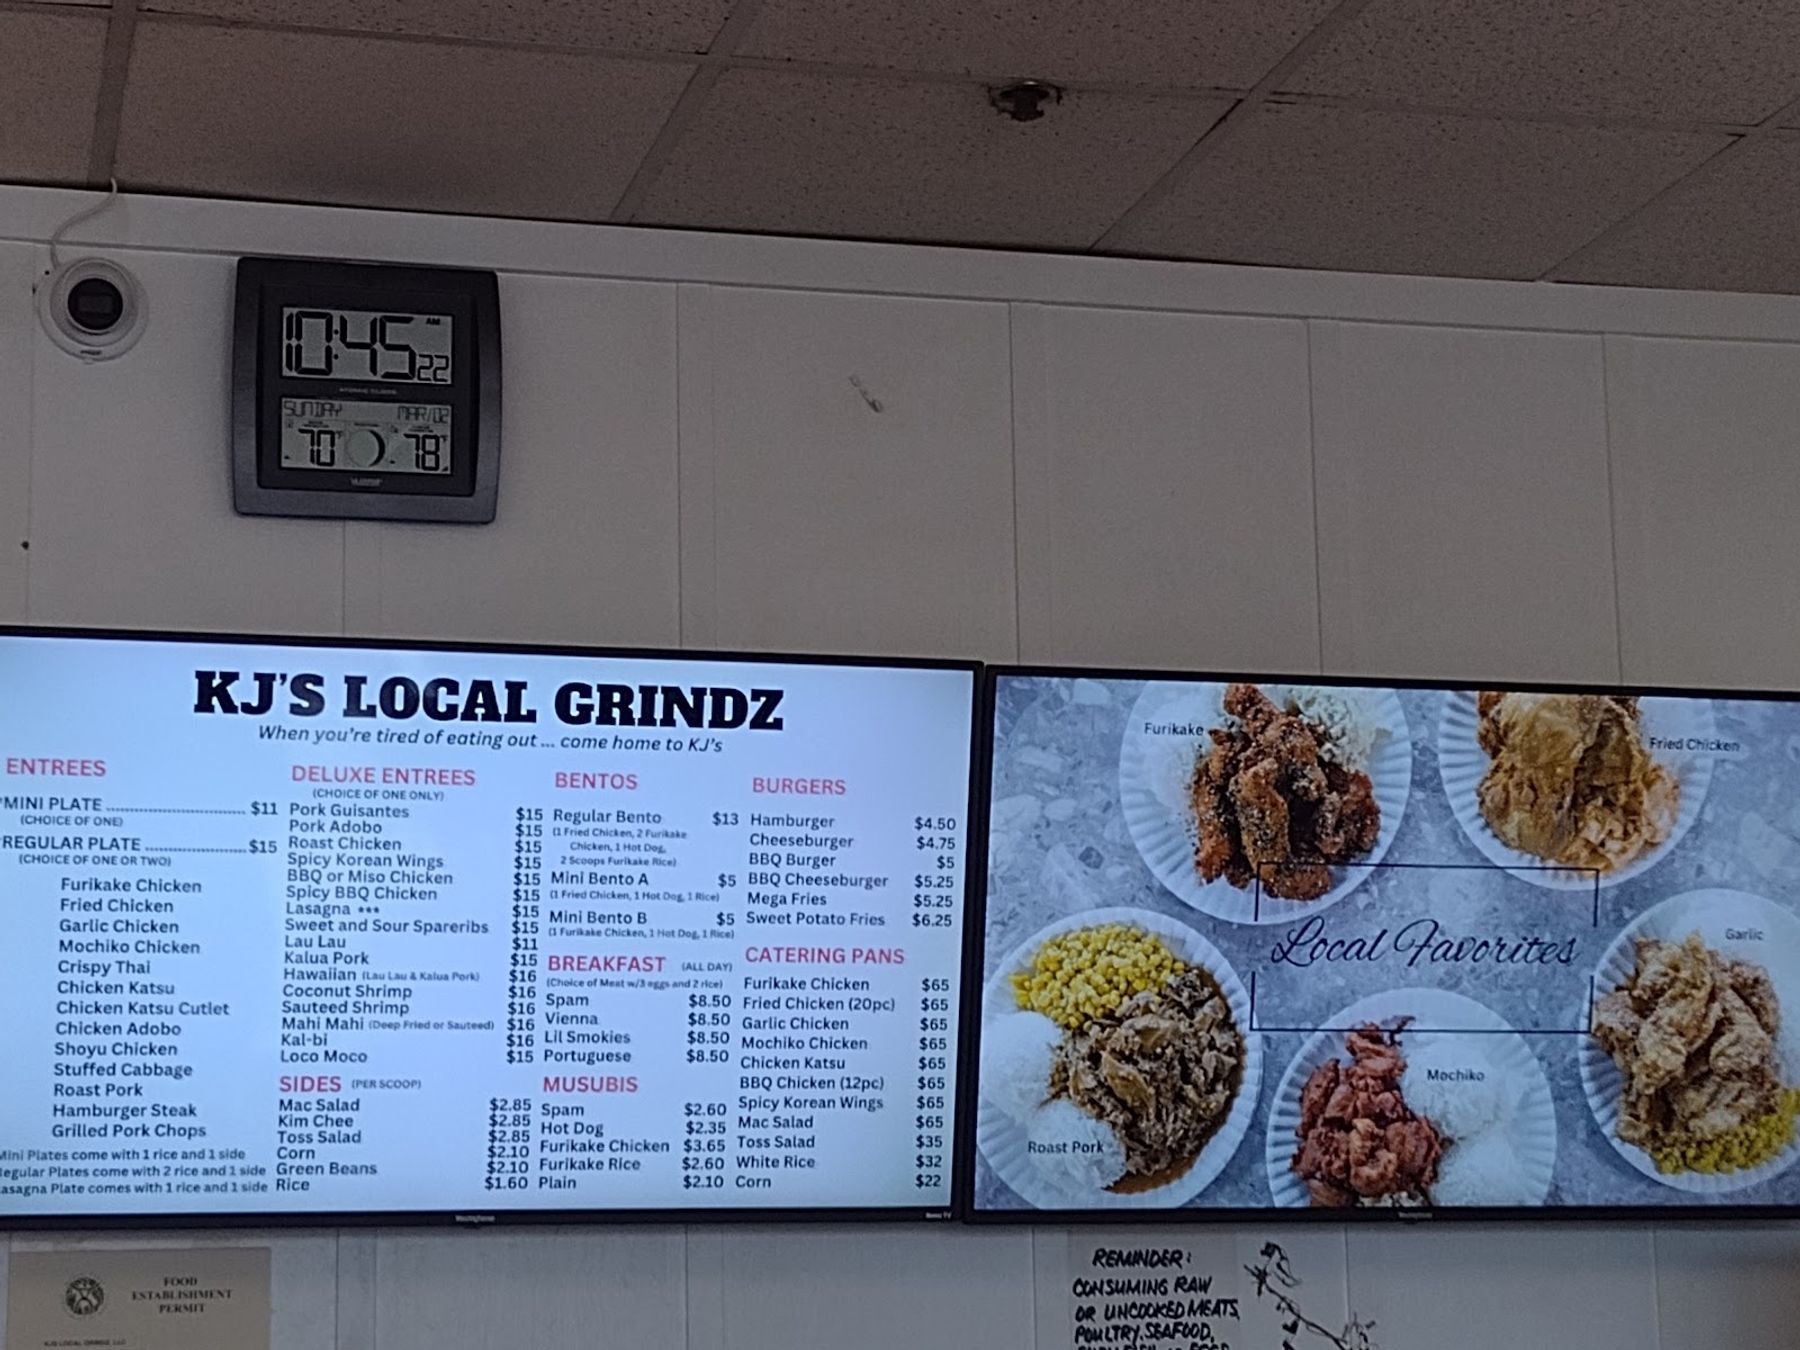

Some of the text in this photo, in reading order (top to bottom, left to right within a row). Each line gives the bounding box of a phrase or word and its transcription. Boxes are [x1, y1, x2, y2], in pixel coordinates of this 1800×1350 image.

[285, 311, 449, 382] 10:45 22
[283, 400, 449, 424] SUNDAY MAR/02
[193, 670, 784, 730] KJ'S LOCAL GRINDZ
[1145, 723, 1204, 737] Furikake
[259, 724, 309, 741] When
[312, 725, 371, 746] you're
[376, 727, 420, 744] tired
[423, 731, 445, 746] of
[447, 731, 505, 751] eating
[507, 733, 537, 747] out
[560, 736, 608, 749] come
[612, 734, 661, 751] home
[666, 737, 683, 751] to
[688, 736, 722, 752] KJ's
[1650, 737, 1740, 752] Fried Chicken
[6, 757, 106, 777] ENTREES
[292, 765, 475, 786] DELUXE ENTREES
[555, 771, 637, 790] BENTOS
[752, 777, 846, 795] BURGERS
[312, 787, 444, 801] (CHOICE OF ONE ONLY)
[289, 802, 409, 818] Pork Guisantes
[553, 808, 661, 826] Regular Bento
[712, 811, 738, 826] $13
[750, 813, 834, 831] Hamburger
[914, 816, 956, 831] $4.50
[289, 819, 382, 834] Pork Adobo
[288, 835, 401, 850] Roast Chicken
[749, 832, 853, 851] Cheeseburger
[916, 835, 955, 851] $4.75
[749, 852, 836, 870] BBQ Burger
[937, 855, 955, 870] $5
[61, 876, 201, 893] Furikake Chicken
[748, 871, 888, 890] BBQ Cheeseburger
[914, 873, 954, 889] $5.25
[60, 897, 173, 913] Fried Chicken
[747, 891, 826, 908] Mega Fries
[913, 893, 953, 908] $5.25
[746, 910, 885, 925] Sweet Potato Fries
[912, 912, 952, 928] $6.25
[59, 918, 179, 933] Garlic Chicken
[284, 934, 346, 948] Lau Lau
[1271, 915, 1580, 968] Local Favorites
[1725, 928, 1764, 941] Garlic
[59, 938, 200, 954] Mochiko Chicken
[745, 946, 904, 964] CATERING PANS
[57, 959, 150, 977] Crispy Thai
[547, 955, 666, 972] BREAKFAST
[681, 961, 732, 972] (ALL DAY)
[57, 979, 174, 994] Chicken Katsu
[744, 975, 869, 991] Furikake Chicken
[921, 977, 949, 992] $65
[282, 983, 412, 1001] Coconut Shrimp
[545, 992, 589, 1009] Spam
[688, 993, 731, 1008] $8.50
[545, 1011, 598, 1025] Vienna
[688, 1011, 730, 1027] $8.50
[55, 1020, 181, 1035] Chicken Adobo
[281, 1033, 327, 1046] Kal-bi
[544, 1029, 630, 1044] Lil Smokies
[687, 1030, 730, 1045] $8.50
[54, 1041, 177, 1059] Shoyu Chicken
[280, 1049, 367, 1063] Loco Moco
[543, 1048, 631, 1065] Portuguese
[686, 1048, 729, 1063] $8.50
[53, 1061, 192, 1080] Stuffed Cabbage
[1427, 1068, 1485, 1082] Mochiko
[53, 1082, 142, 1097] Roast Pork
[279, 1075, 341, 1093] SIDES
[351, 1079, 421, 1089] (PER SCOOP)
[543, 1075, 638, 1093] MUSUBIS
[53, 1103, 196, 1120] Hamburger Steak
[541, 1102, 584, 1120] Spam
[684, 1102, 726, 1117] $2.60
[540, 1121, 603, 1138] Hot Dog
[685, 1120, 726, 1135] $2.35
[276, 1146, 315, 1159] Corn
[683, 1138, 725, 1153] $3.65
[1027, 1141, 1105, 1154] Roast Pork
[276, 1161, 377, 1175] Green Beans
[539, 1156, 640, 1171] Furikake Rice
[682, 1156, 724, 1171] $2.60
[735, 1154, 815, 1168] White Rice
[915, 1154, 942, 1169] $32
[276, 1177, 310, 1191] Rice
[538, 1175, 576, 1189] Plain
[683, 1174, 724, 1189] $2.10
[735, 1174, 771, 1188] Corn
[915, 1173, 941, 1188] $22
[1092, 1248, 1192, 1269] REMINDER:
[164, 1277, 198, 1288] FOOD
[1073, 1275, 1212, 1297] CONSUMING RAW
[131, 1289, 233, 1301] ESTABLISHMENT
[159, 1303, 206, 1314] PERMIT
[1075, 1306, 1096, 1323] OR
[1104, 1301, 1185, 1321] UNCOOKED
